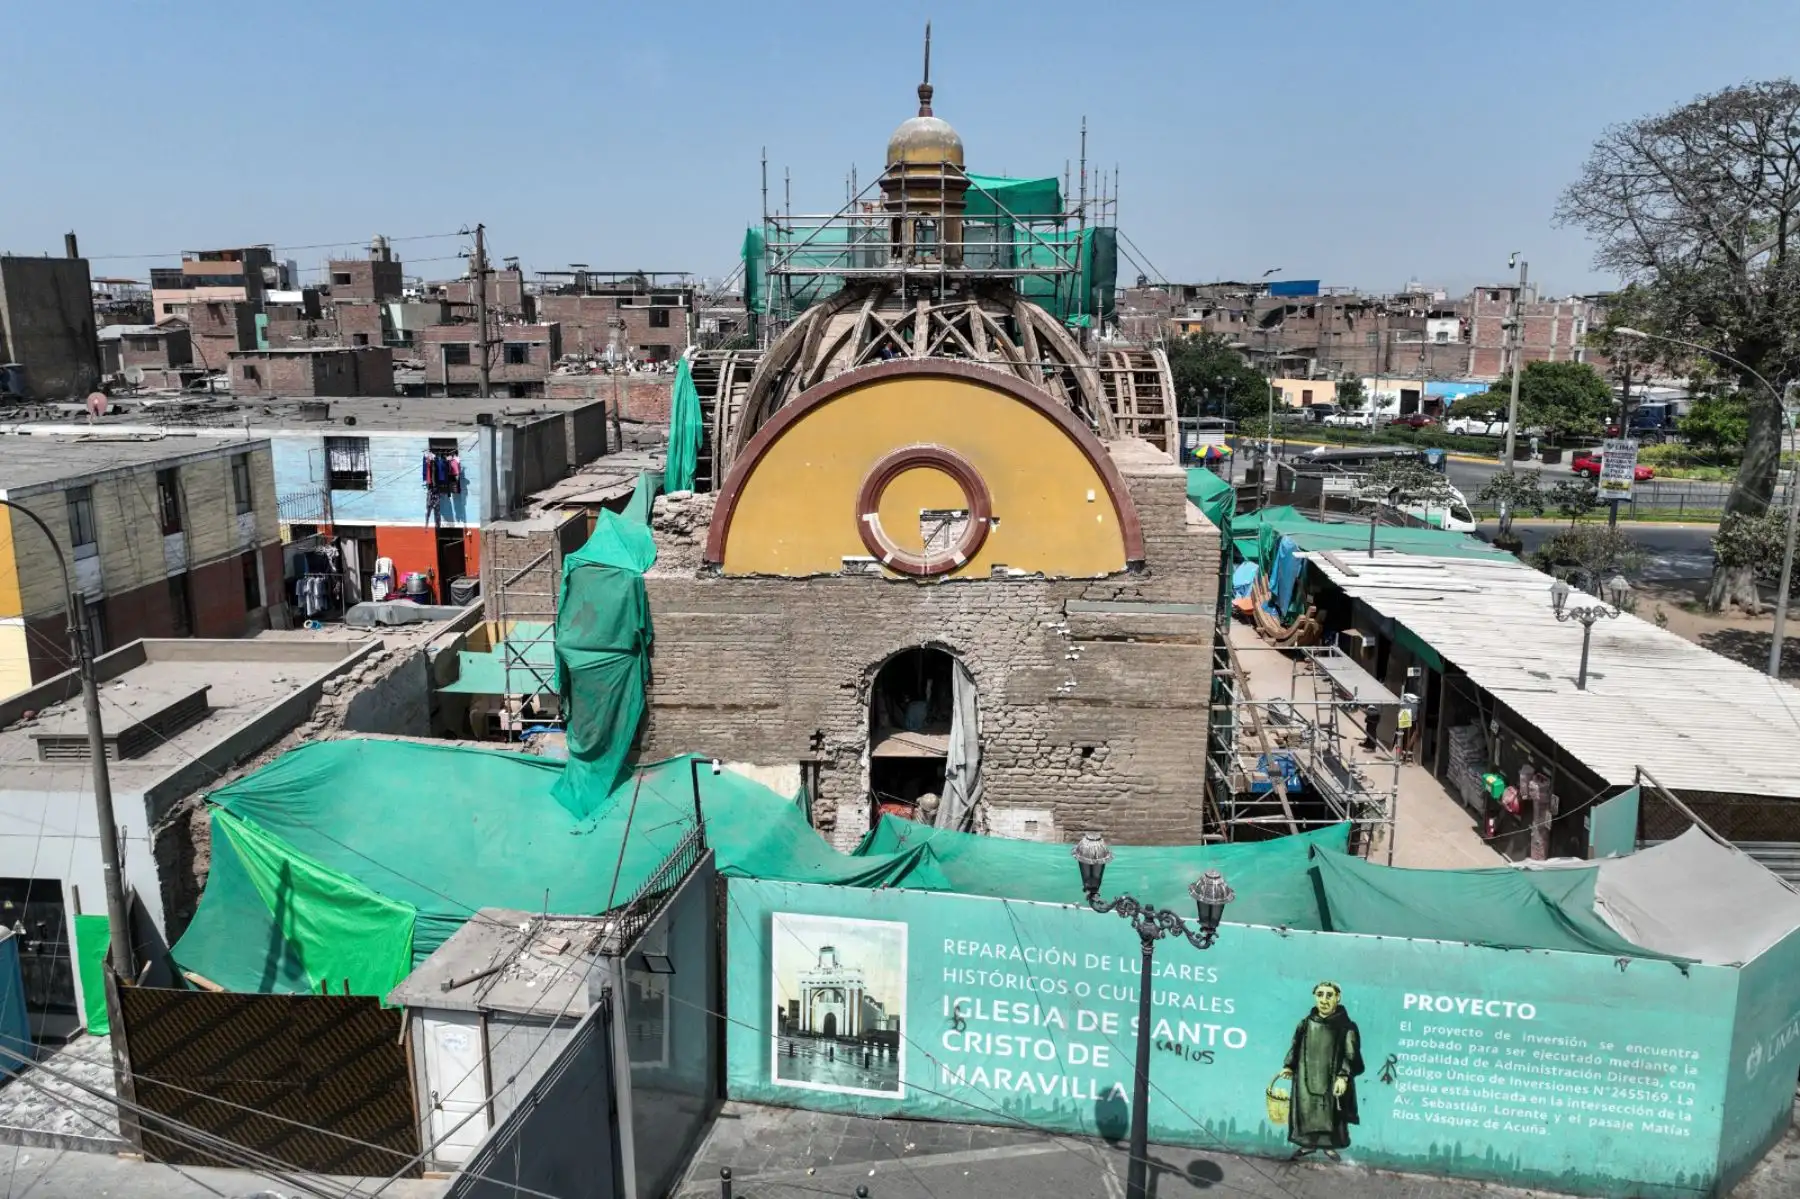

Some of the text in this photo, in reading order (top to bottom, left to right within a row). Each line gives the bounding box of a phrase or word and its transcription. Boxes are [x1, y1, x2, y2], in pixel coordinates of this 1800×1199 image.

[944, 938, 1077, 968] REPARACIÓN
[1085, 954, 1111, 971] DE
[943, 968, 1235, 1014] HISTÓRICOS O CULURALES
[1403, 993, 1536, 1020] PROYECTO
[943, 995, 1065, 1029] IGLESIA
[1077, 1009, 1119, 1035] DE
[942, 1029, 1110, 1068] CRISTO DE
[1398, 1037, 1698, 1075] aprobado para ser ejecutado mediante la
[1400, 1021, 1700, 1060] El proyecto de inversión se encuentra
[941, 1064, 1151, 1104] MARAVILLA
[1396, 1051, 1696, 1091] modalidad de Administración Directa, con
[1396, 1065, 1442, 1080] Código
[1447, 1067, 1485, 1083] Único
[1489, 1075, 1505, 1085] de
[1510, 1076, 1589, 1095] Inversiones
[1677, 1094, 1694, 1106] La
[1394, 1095, 1413, 1106] Av.
[1421, 1097, 1486, 1113] Sebastián
[1494, 1105, 1547, 1120] Lorente
[1554, 1114, 1562, 1124] y
[1568, 1113, 1580, 1125] el
[1589, 1117, 1634, 1132] pasaje
[1441, 1084, 1470, 1097] está
[1473, 1087, 1526, 1103] ubicada
[1530, 1095, 1546, 1105] en
[1550, 1095, 1563, 1107] la
[1567, 1097, 1654, 1117] intersección
[1658, 1108, 1675, 1119] de
[1679, 1110, 1692, 1122] la
[1483, 1118, 1500, 1129] de
